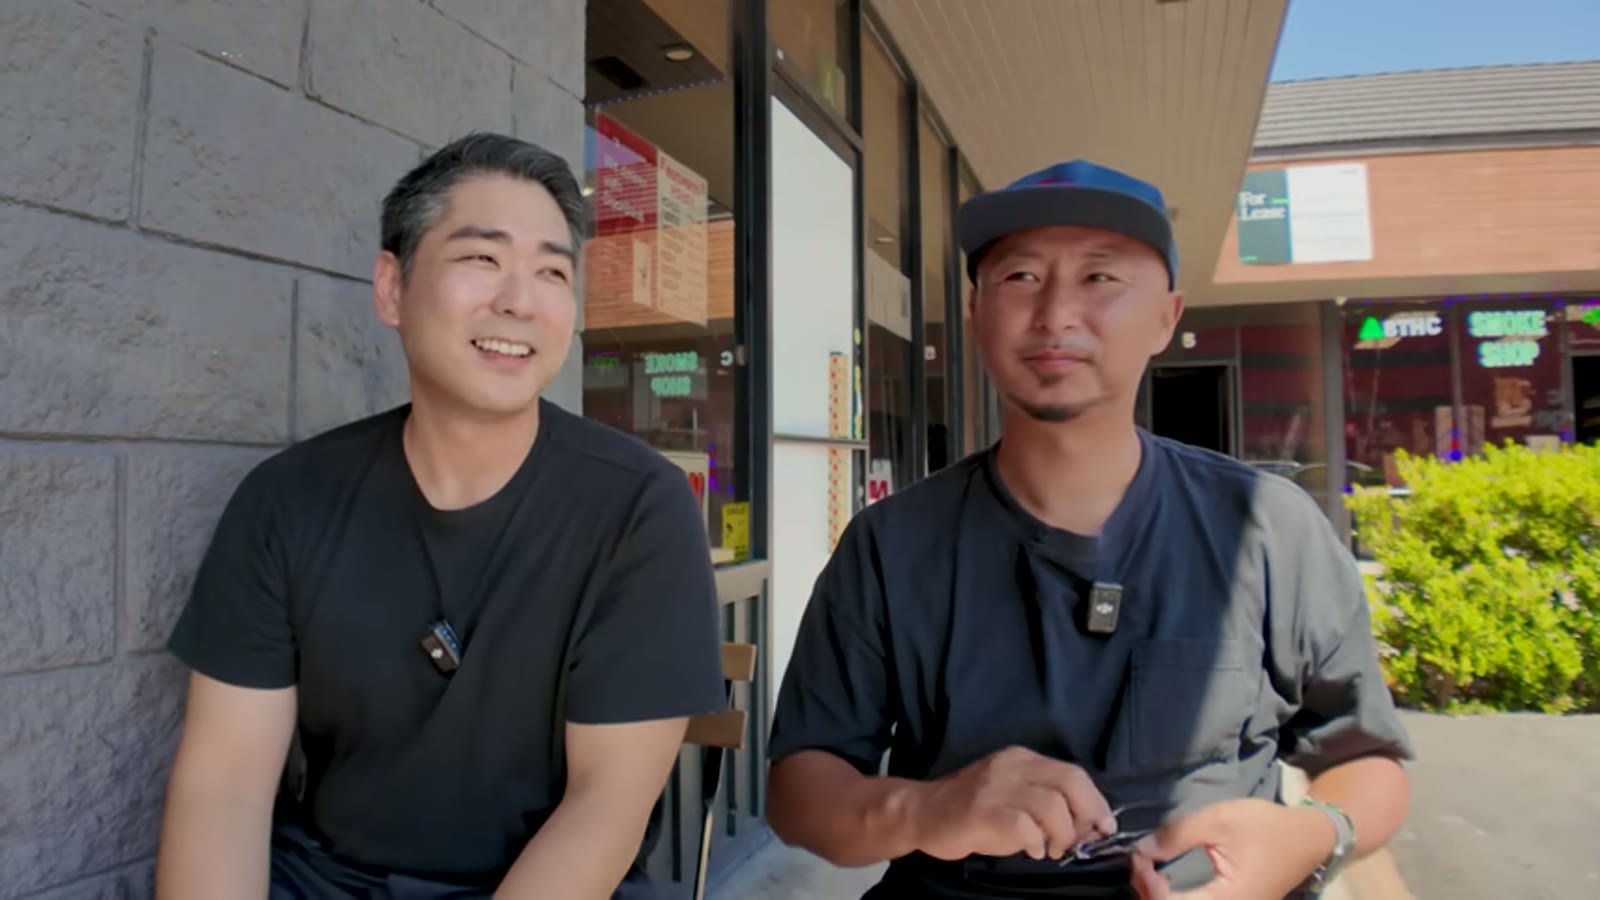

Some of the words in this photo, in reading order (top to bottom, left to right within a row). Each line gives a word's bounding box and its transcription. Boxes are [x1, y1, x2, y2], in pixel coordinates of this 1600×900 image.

[1238, 191, 1266, 206] For
[1240, 206, 1287, 221] Lease
[1467, 310, 1548, 337] SMOKE
[1477, 341, 1541, 368] SHOP
